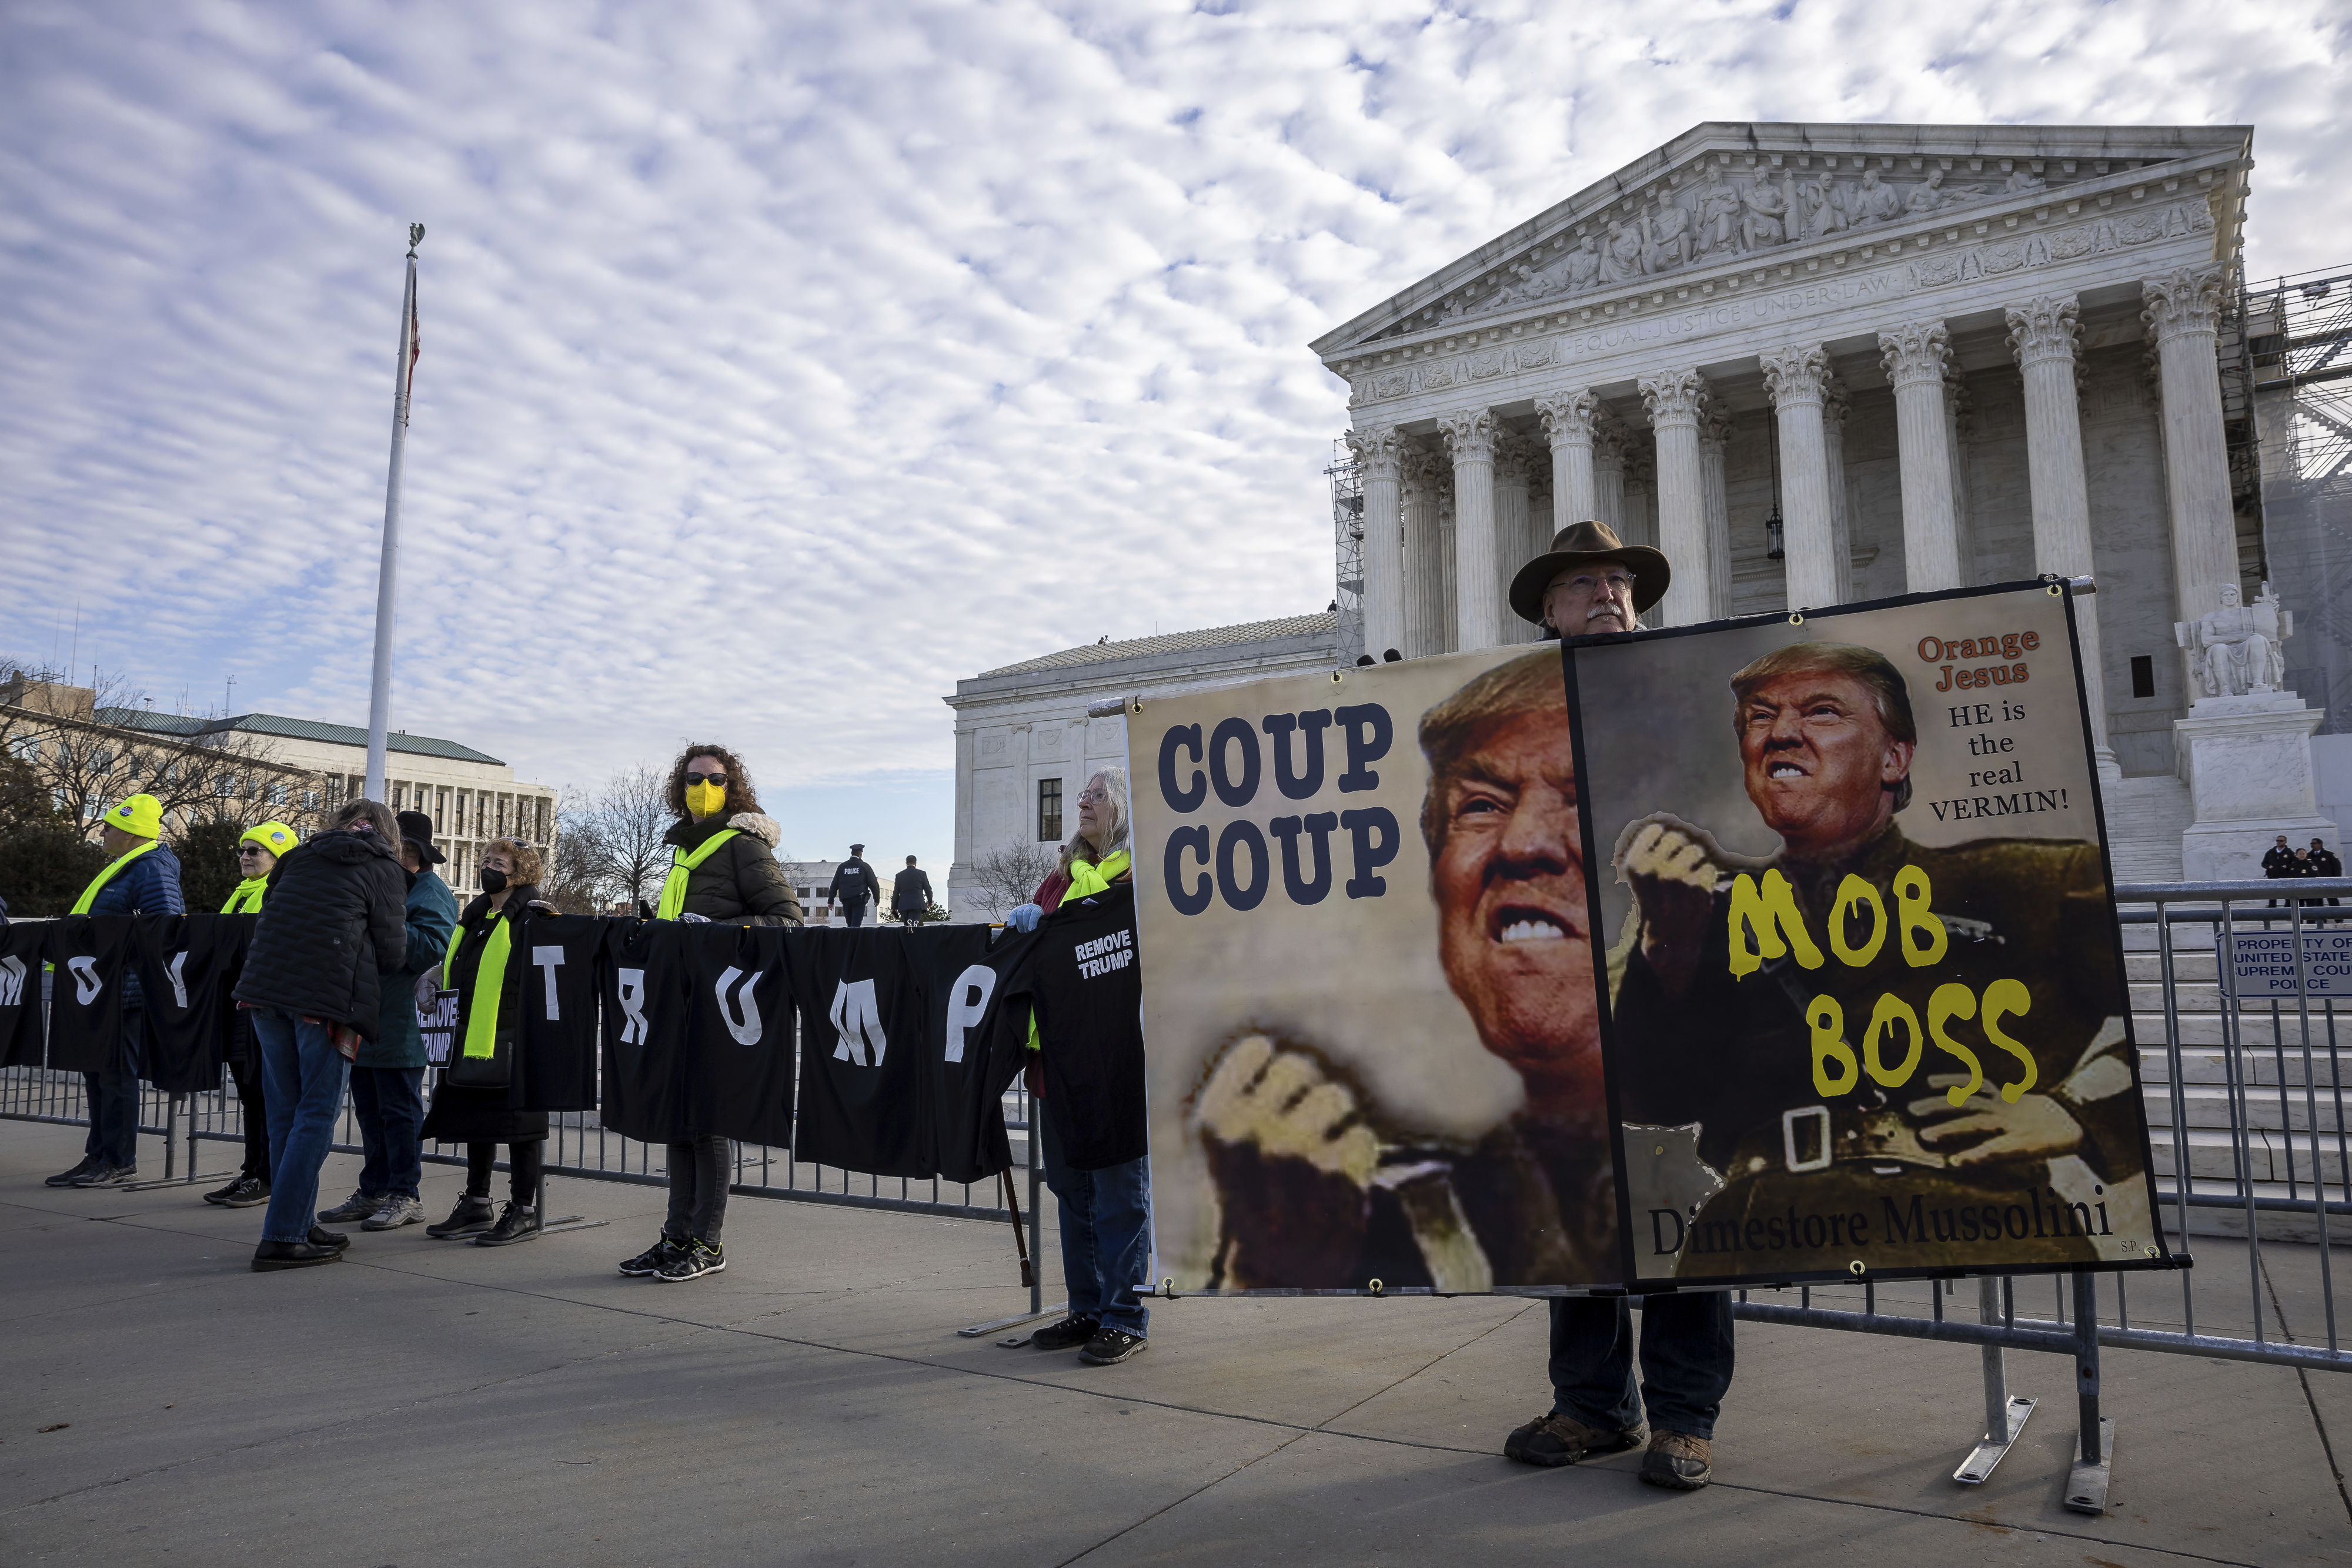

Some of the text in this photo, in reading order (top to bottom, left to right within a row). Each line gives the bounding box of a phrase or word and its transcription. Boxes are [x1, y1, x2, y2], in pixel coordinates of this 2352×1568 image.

[1574, 273, 1891, 354] EQUAL JUSTICE UNDER LAW
[1918, 630, 2040, 663] Orange
[1936, 663, 2029, 692] Jesus
[1947, 700, 2026, 728] HE is
[1158, 703, 1394, 814] COUP
[1967, 733, 2014, 757] the
[1968, 760, 2024, 787] real
[1929, 788, 2069, 822] VERMIN!
[1163, 806, 1401, 916] COUP
[1728, 864, 1948, 981] MOB
[1075, 929, 1131, 962] REMOVE
[2234, 952, 2352, 963] UNITED STATE
[2237, 938, 2324, 950] PROPETY
[1078, 949, 1133, 979] TRUMP
[2227, 965, 2352, 977] UPREM COU
[2270, 979, 2330, 989] POLCE
[420, 1032, 450, 1062] RUMP
[1806, 978, 2037, 1107] BOSS
[1648, 1183, 2113, 1256] Dimestore Mussolini
[2120, 1240, 2141, 1252] S.P.
